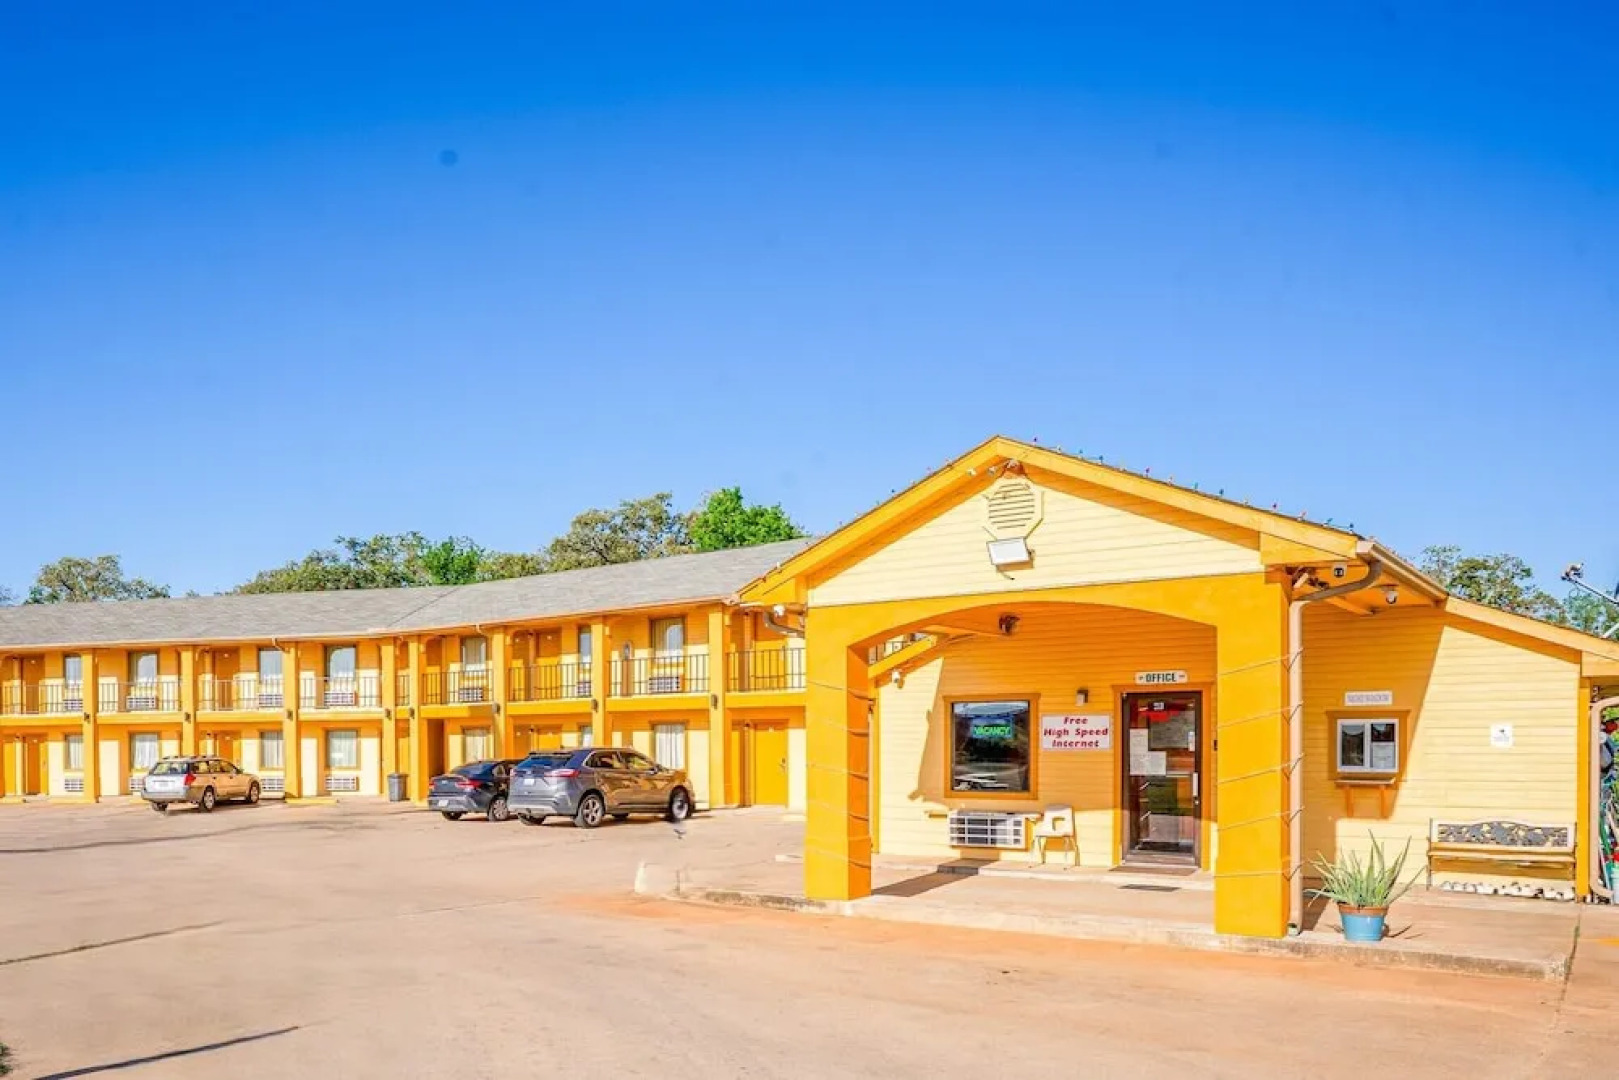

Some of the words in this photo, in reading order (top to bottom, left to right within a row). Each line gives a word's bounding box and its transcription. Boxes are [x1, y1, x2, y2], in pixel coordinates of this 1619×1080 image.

[1145, 673, 1177, 683] OFFICE
[1063, 716, 1089, 725] Free
[1043, 728, 1070, 738] High
[1075, 728, 1109, 738] Speed
[1052, 739, 1100, 747] Internet
